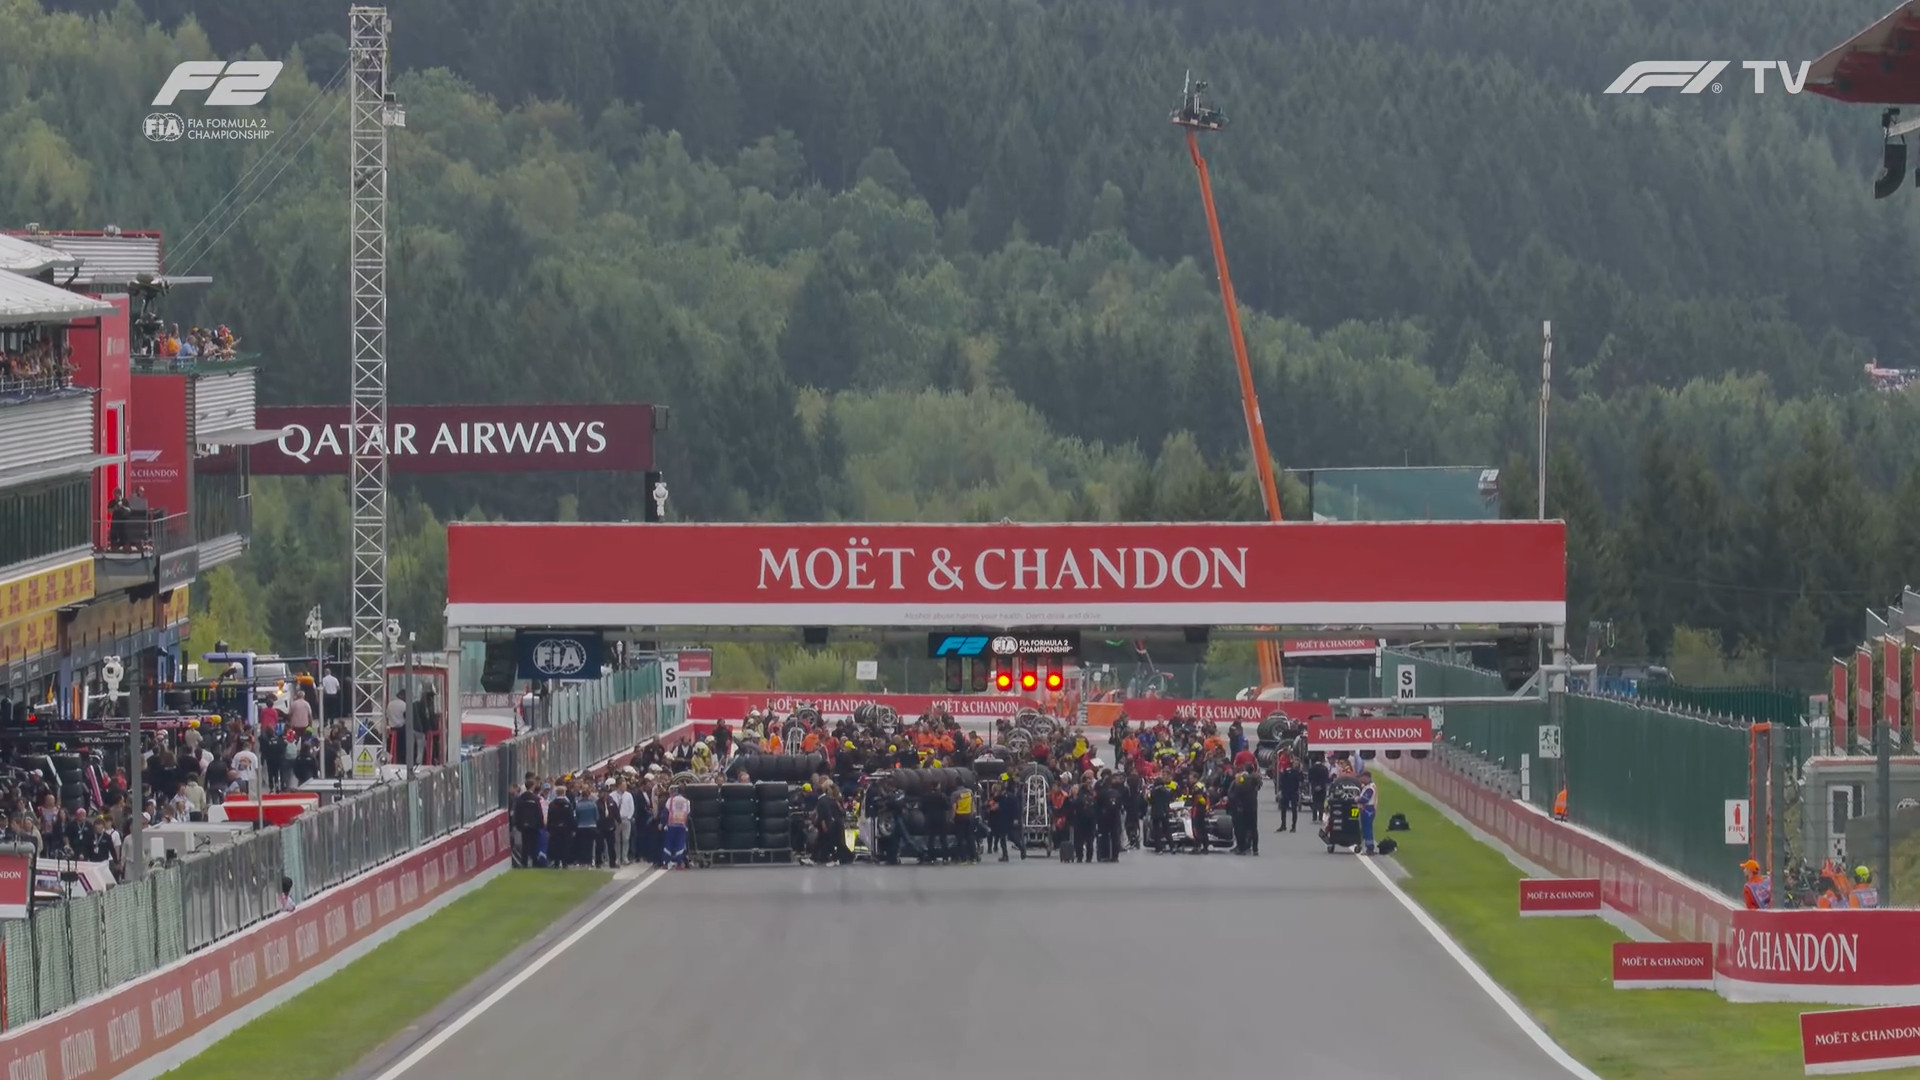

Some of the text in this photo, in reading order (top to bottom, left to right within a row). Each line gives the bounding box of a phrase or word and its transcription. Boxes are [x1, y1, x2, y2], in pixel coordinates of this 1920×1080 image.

[278, 421, 607, 464] QATAR AIRWAYS
[137, 469, 179, 477] CHANDON
[756, 537, 1249, 591] MOËT & CHANDON
[937, 636, 990, 656] F2
[1325, 639, 1366, 649] CHANDON
[961, 701, 970, 713] &
[970, 701, 1019, 714] CHANDON
[1213, 705, 1262, 719] CHANDON
[1319, 726, 1423, 740] MOËT & CHANDON
[1728, 825, 1745, 833] FIRE
[1556, 890, 1595, 899] CHANDON
[1749, 930, 1859, 973] CHANDON
[1649, 957, 1657, 967] &
[1657, 957, 1705, 967] CHANDON
[1815, 1026, 1920, 1046] MOËT & CHANDON
